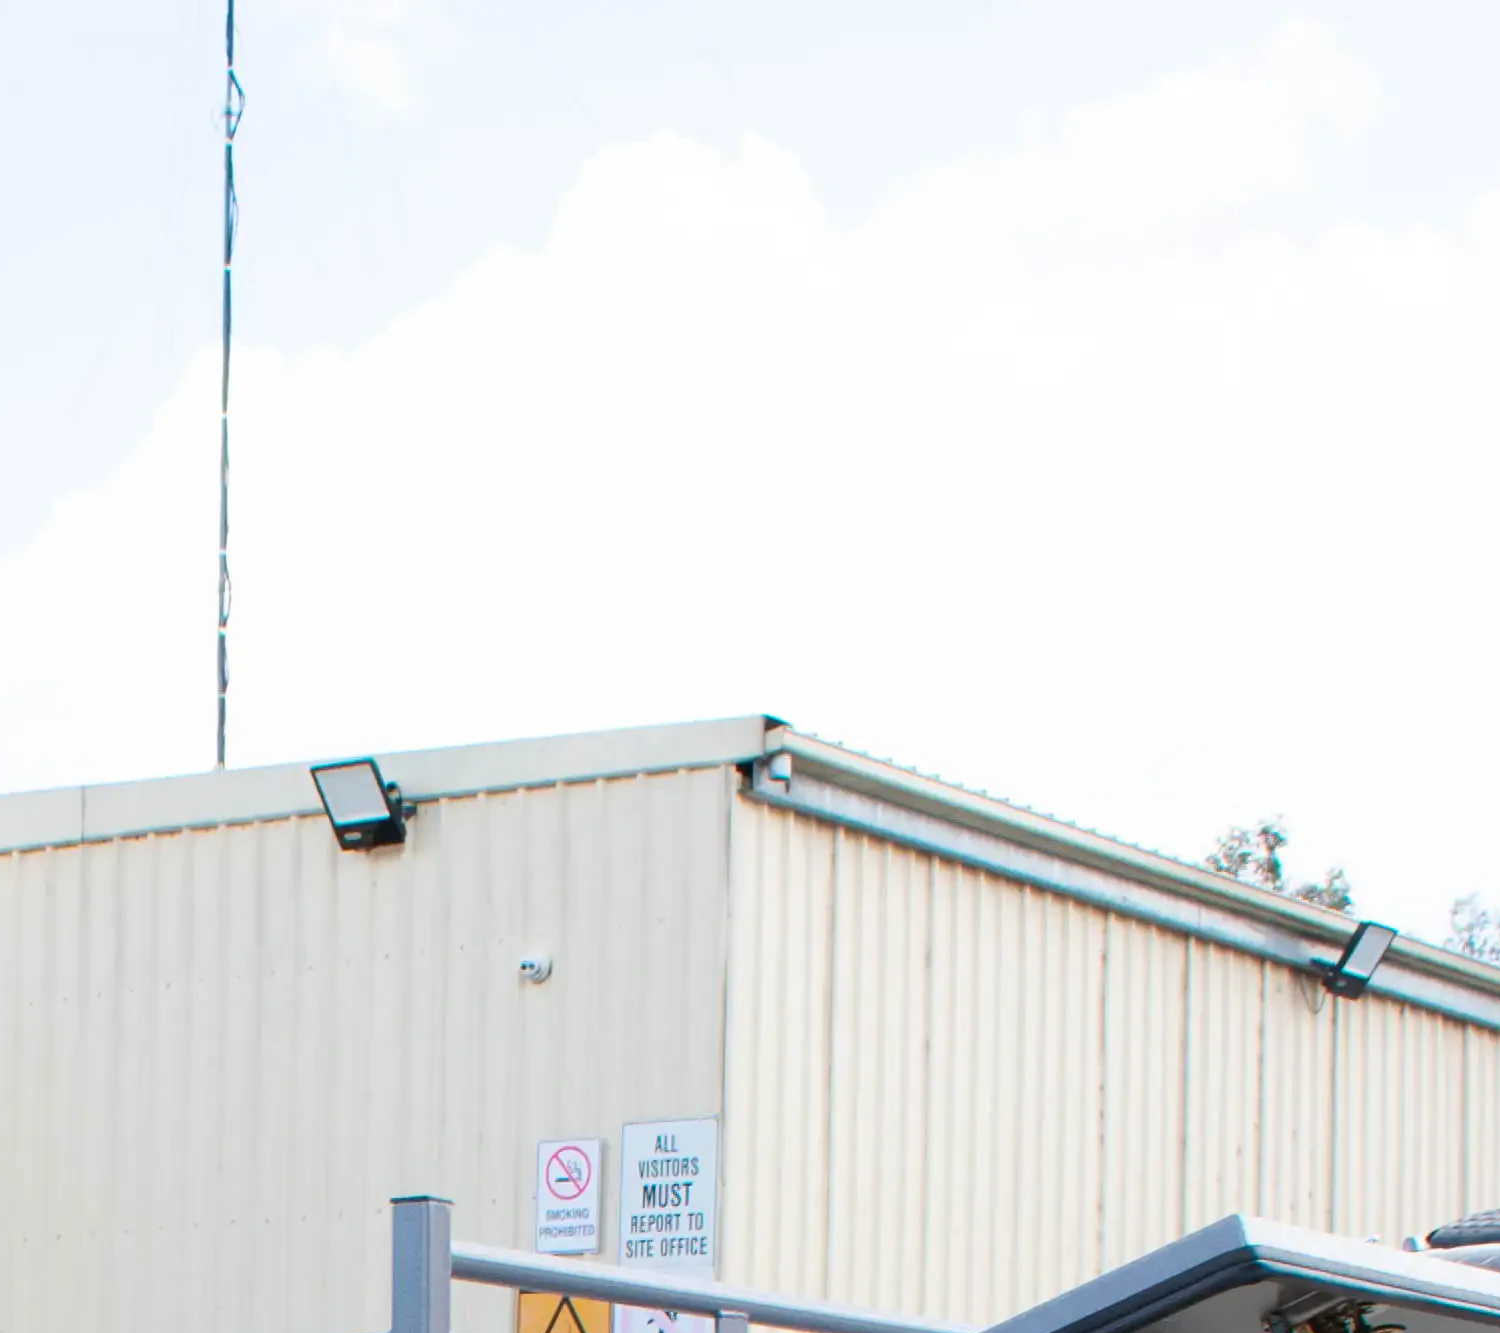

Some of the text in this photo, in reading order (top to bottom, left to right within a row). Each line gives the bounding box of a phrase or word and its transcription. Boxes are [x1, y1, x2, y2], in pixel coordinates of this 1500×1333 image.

[654, 1135, 678, 1154] ALL
[638, 1157, 700, 1178] VISITORS
[642, 1183, 693, 1209] MUST
[545, 1208, 590, 1221] SMOKING
[630, 1212, 704, 1234] REPORT TO
[538, 1224, 596, 1240] PROHIBITED
[625, 1236, 708, 1259] SITE OFFICE
